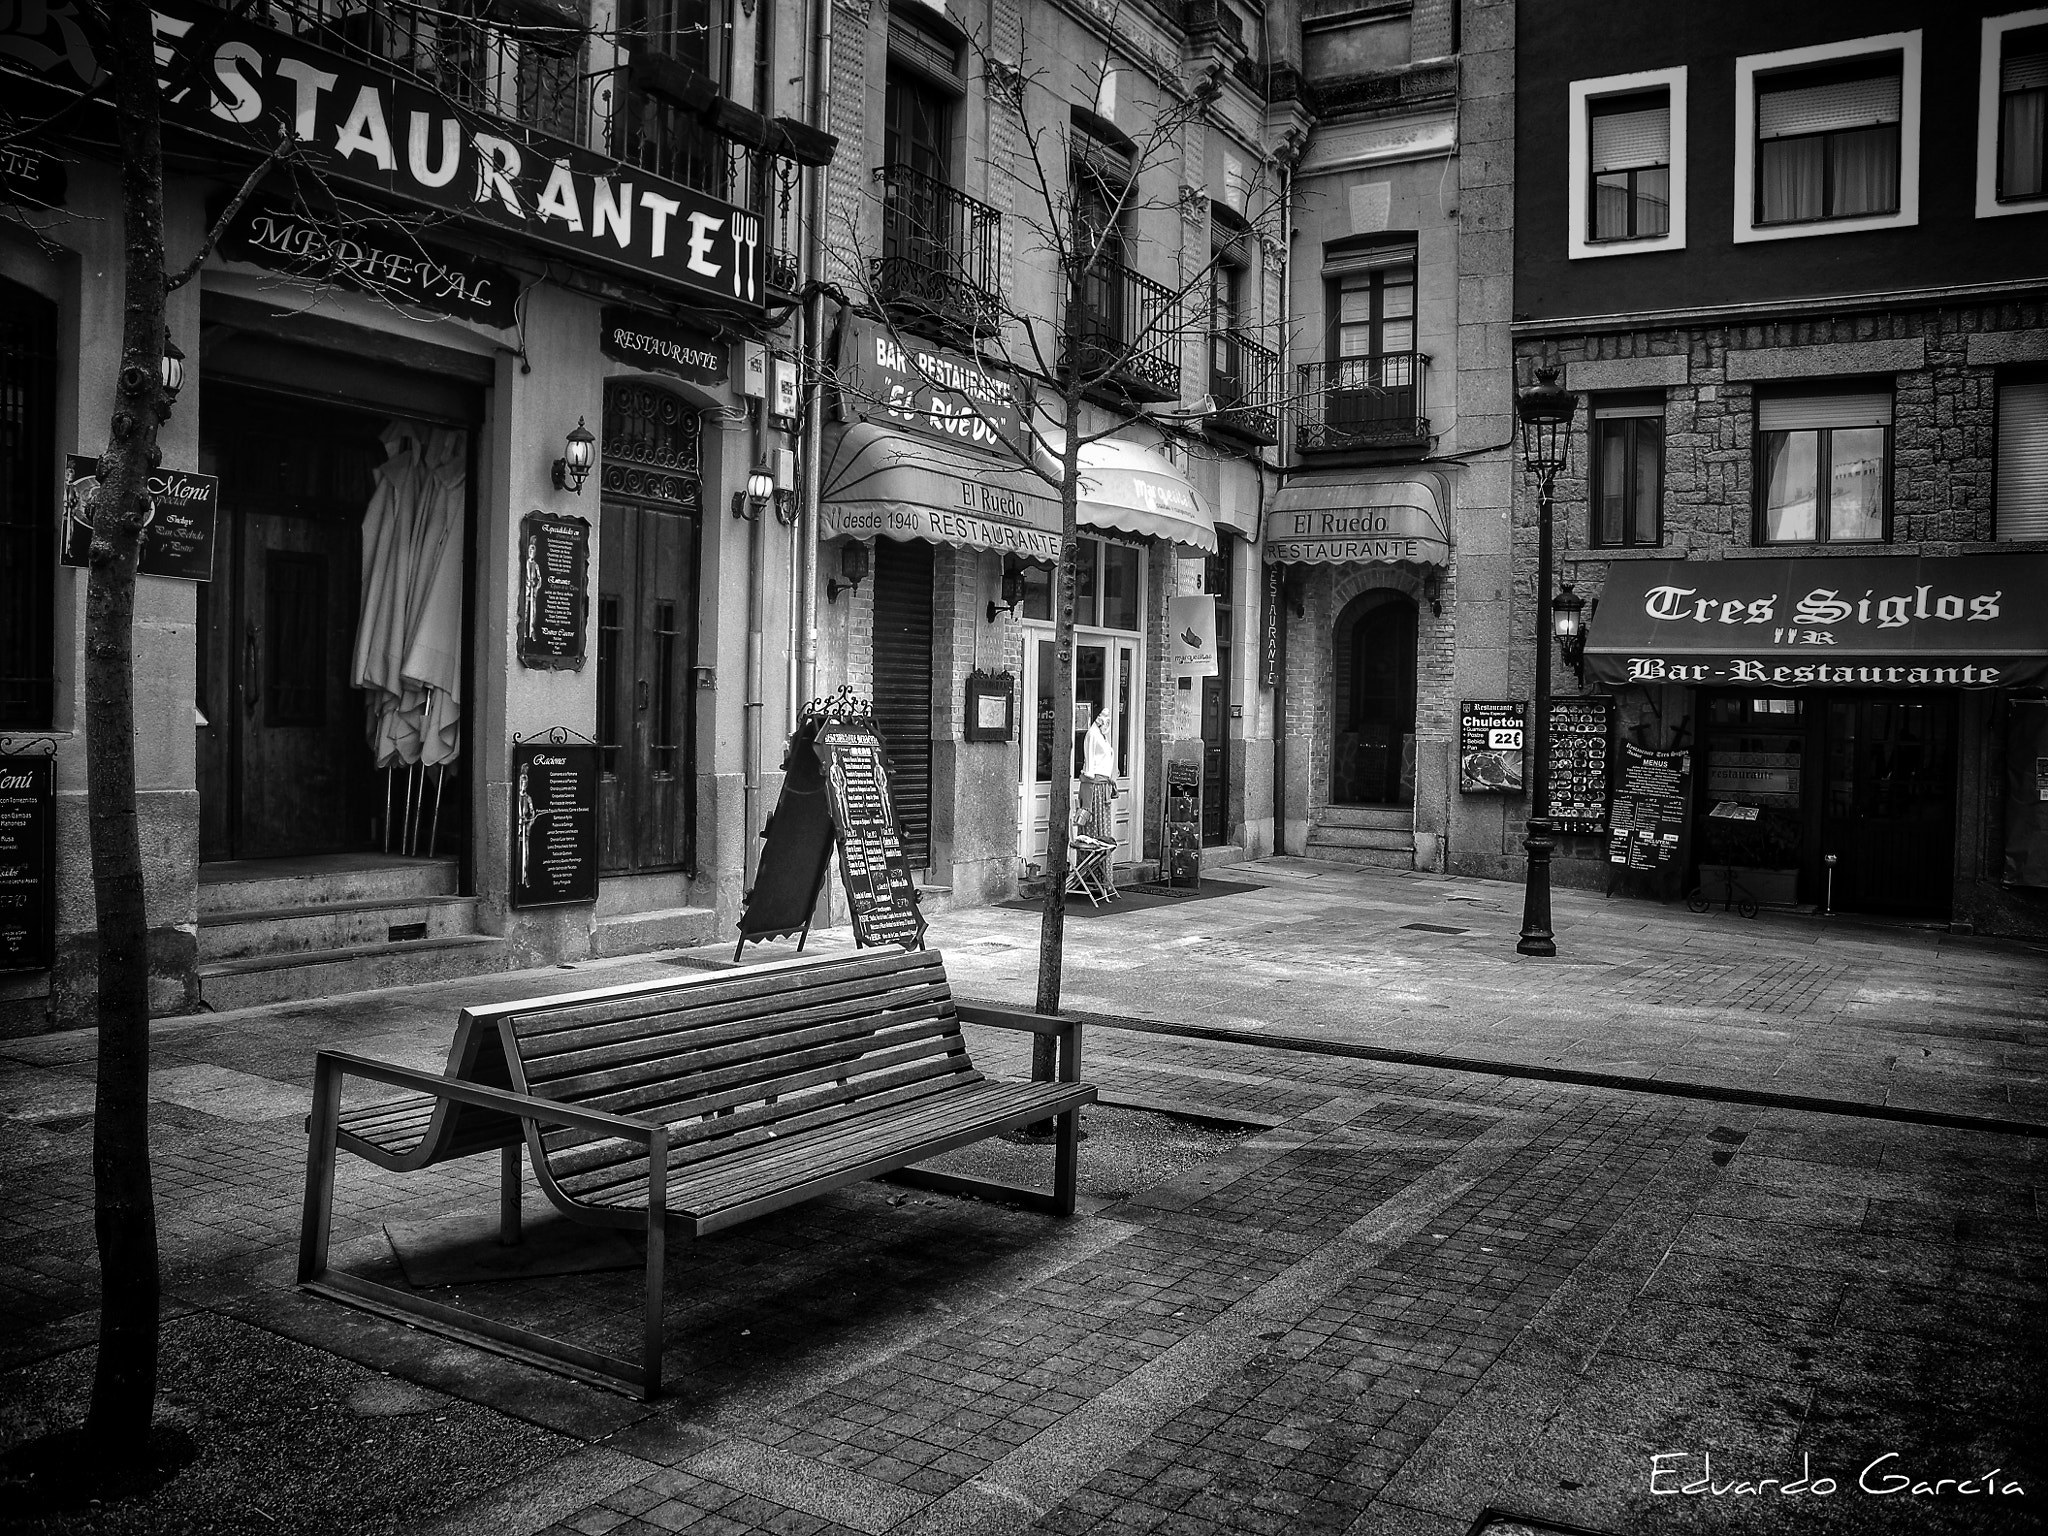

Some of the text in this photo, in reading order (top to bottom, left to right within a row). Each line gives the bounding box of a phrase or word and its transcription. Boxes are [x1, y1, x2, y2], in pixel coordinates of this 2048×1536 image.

[248, 215, 494, 307] MEDIEVAL
[612, 327, 719, 372] RESTAURANTE
[876, 337, 1011, 408] BAR RESTAURANTE
[146, 475, 211, 501] Menú
[961, 481, 1025, 518] El Ruedo
[844, 511, 919, 530] desde 1940
[1294, 511, 1387, 534] El Ruedo
[929, 511, 1061, 557] RESTAURANTE
[1267, 541, 1418, 559] RESTAURANTE
[1643, 584, 2003, 628] Tres Siglos
[1626, 657, 2001, 684] Bar-Restaurante
[1473, 703, 1514, 712] Restaurante
[1462, 716, 1525, 727] Chuletón
[1642, 758, 1669, 767] MENUS
[1711, 769, 1774, 780] restaurante
[0, 769, 33, 790] enú
